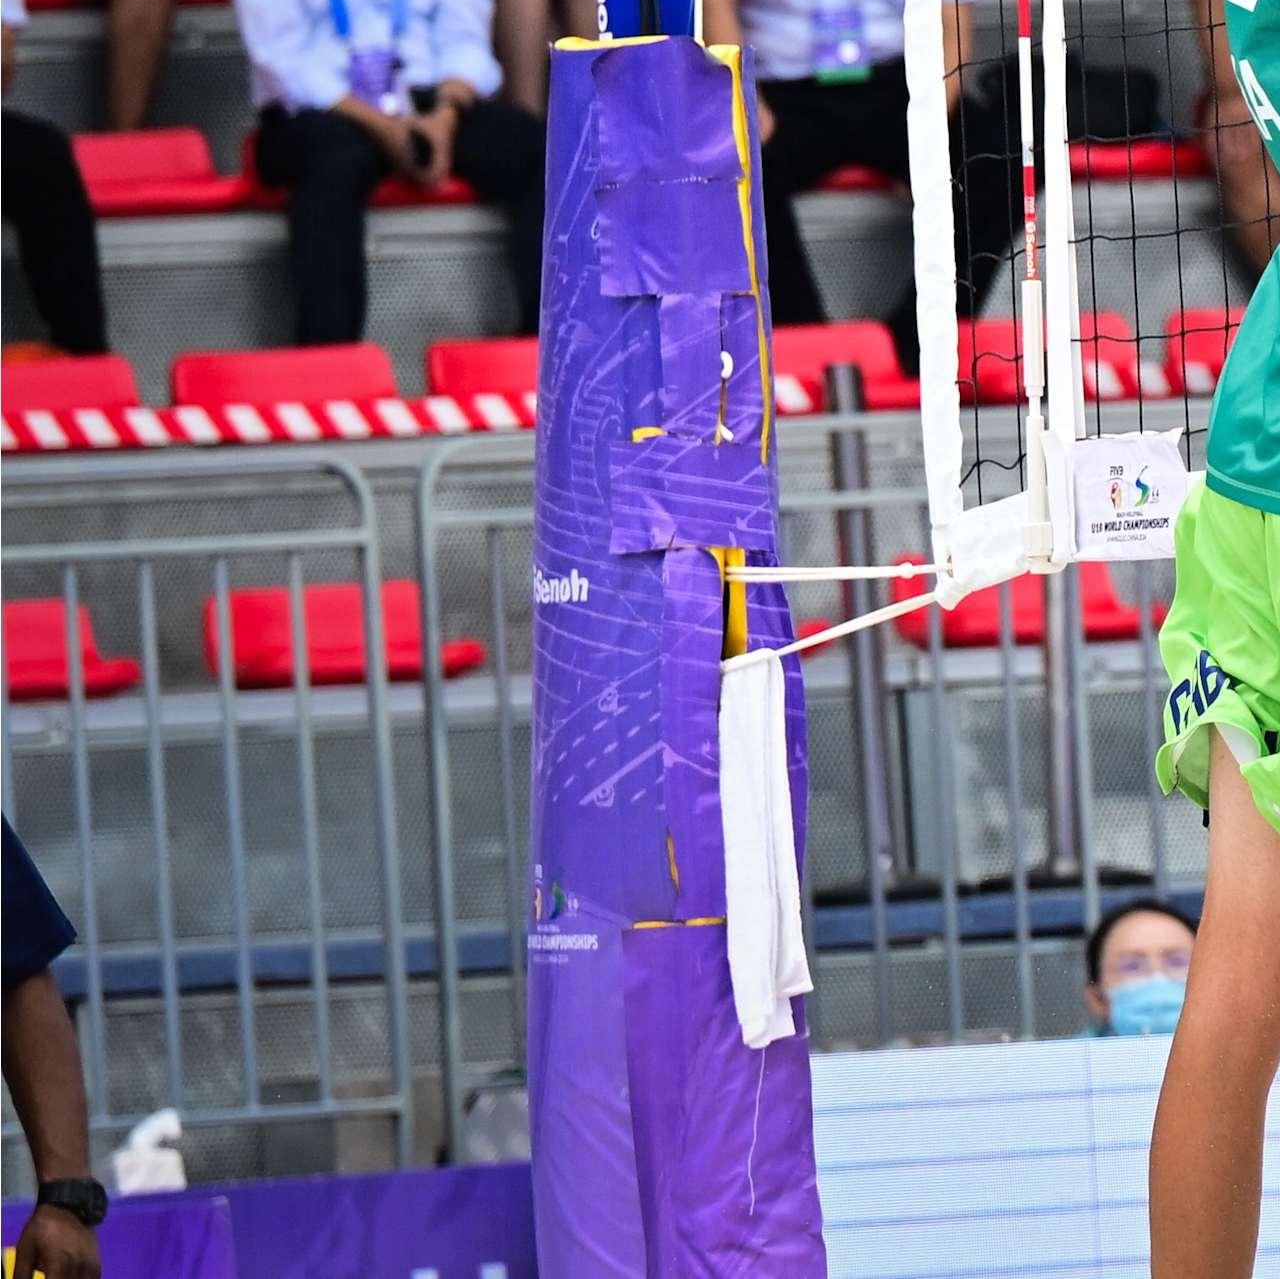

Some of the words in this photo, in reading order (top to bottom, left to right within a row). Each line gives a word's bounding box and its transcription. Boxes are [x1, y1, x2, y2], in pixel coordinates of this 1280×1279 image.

[1109, 465, 1123, 477] FIVB
[1104, 520, 1122, 533] WORLD
[1122, 517, 1171, 531] CHAMPIONSHIPS
